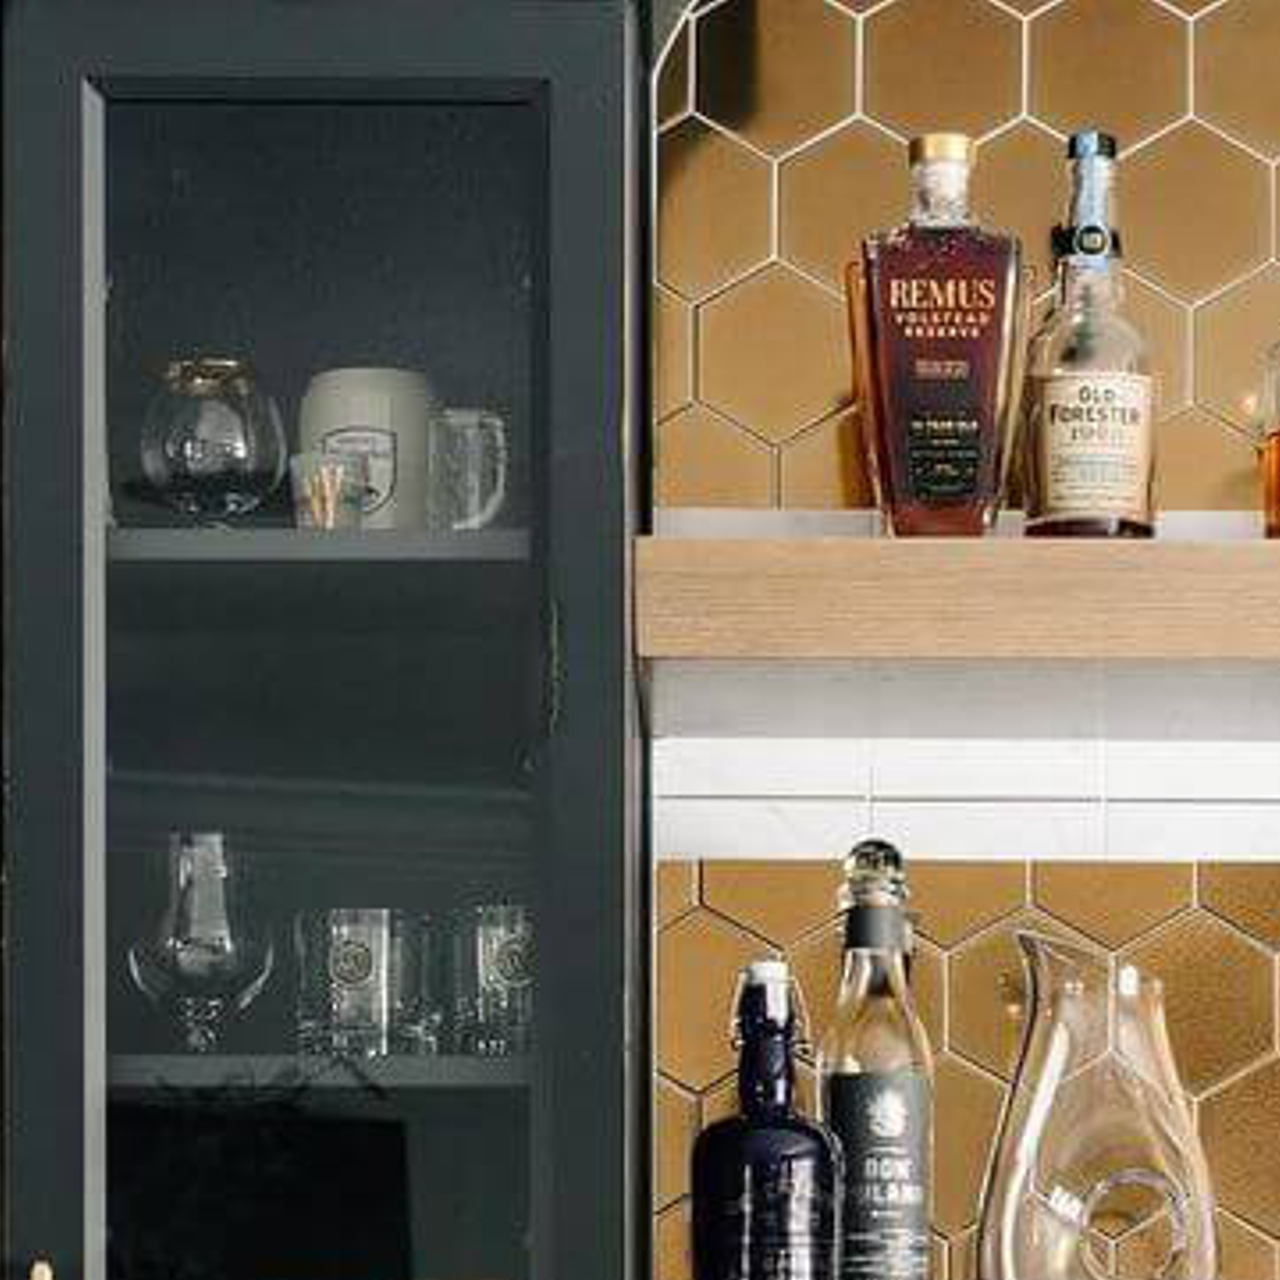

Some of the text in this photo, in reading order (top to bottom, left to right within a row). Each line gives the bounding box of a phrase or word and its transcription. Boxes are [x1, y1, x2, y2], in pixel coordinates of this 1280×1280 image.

[890, 279, 996, 309] REMUS
[1078, 385, 1116, 404] OLD
[1049, 403, 1142, 426] FORESTER
